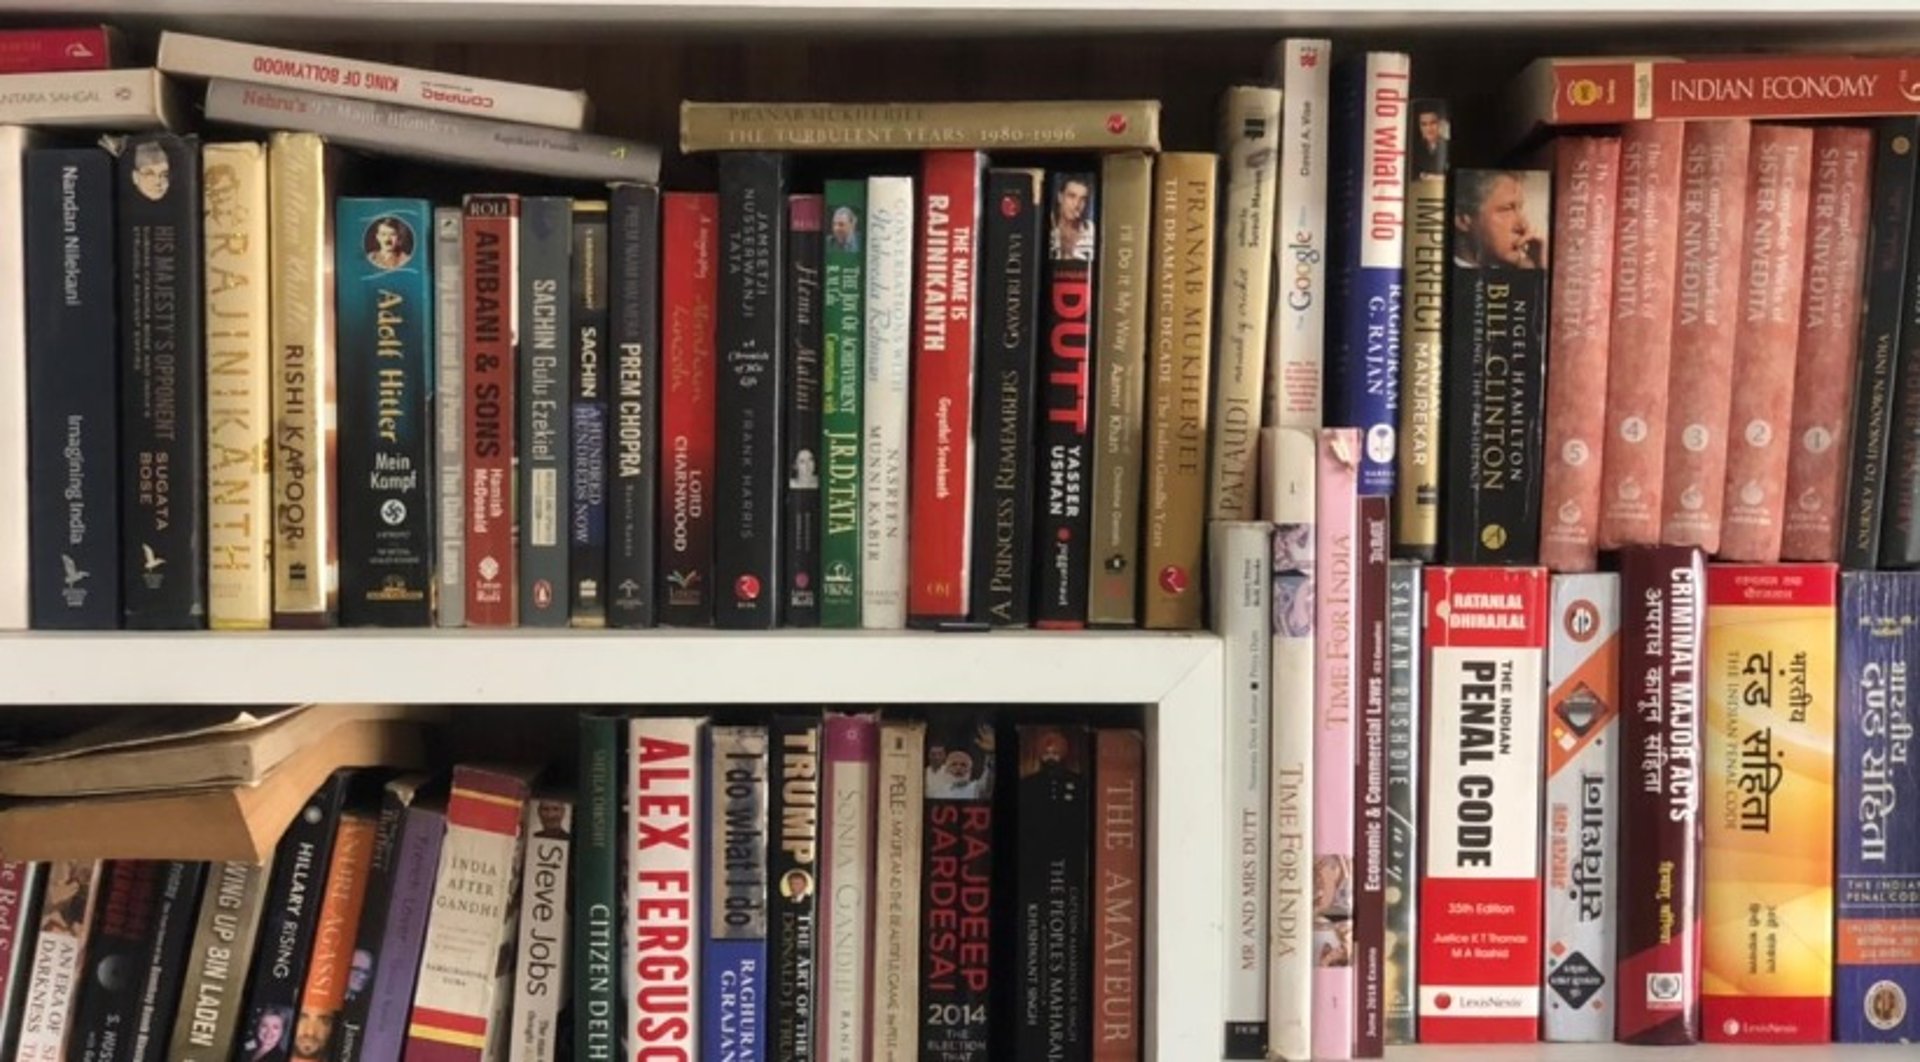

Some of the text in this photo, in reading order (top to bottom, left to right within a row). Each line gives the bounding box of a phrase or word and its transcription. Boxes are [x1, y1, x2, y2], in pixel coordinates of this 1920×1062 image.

[252, 56, 399, 93] KING OF BOLLYWOOD
[1299, 100, 1313, 126] Vise
[1670, 78, 1754, 101] INDIAN
[1761, 75, 1879, 100] ECONOMY
[729, 128, 1077, 143] THE TURBULENT YEARS 1980-1996
[1299, 142, 1312, 177] David
[1369, 71, 1408, 243] I do what I do
[62, 165, 82, 307] Nandan Nilekani
[730, 232, 742, 274] TATA
[743, 188, 756, 318] NUSSERWANJI
[756, 212, 769, 296] JAMSETJI
[924, 194, 950, 351] RAJINIKANTH
[950, 227, 971, 321] THE NAME IS
[1287, 229, 1321, 312] Google
[1411, 196, 1446, 334] IMPERFECT
[1617, 142, 1641, 319] SISTER NIVEDITA
[531, 279, 557, 350] SACHIN
[1157, 177, 1178, 383] THE DRAMATIC DECADE
[1178, 179, 1207, 475] PRANAB MUKHERJEE
[376, 288, 405, 443] Adolf Hitler
[474, 230, 501, 460] AMBANI & SONS
[531, 355, 557, 396] Gulu
[580, 326, 597, 399] SACHIN
[619, 343, 642, 397] PREM
[794, 264, 819, 411] Hema Malini
[1048, 281, 1090, 434] DUTT
[1366, 295, 1387, 396] G. RAJAN
[1385, 283, 1402, 410] RAGHURAM
[531, 399, 557, 462] Ezekiel
[989, 233, 1023, 621] A PRINCESS REMEMBERS GAYATRI DEVI
[1411, 342, 1430, 466] MANJREKAR
[1482, 281, 1510, 491] BILL CLINTON
[1509, 300, 1527, 482] NIGEL HAMILTON
[65, 414, 87, 545] Imagining India
[139, 452, 153, 505] BOSE
[284, 344, 305, 544] RISHI KAPOOR
[369, 469, 418, 493] Kampf
[375, 452, 411, 472] Mein
[618, 401, 642, 479] CHOPRA
[1049, 445, 1064, 515] USMAN
[1065, 446, 1082, 518] YASSER
[1218, 397, 1252, 513] PATAUDI
[155, 452, 169, 532] SUGATA
[473, 468, 488, 534] McDonald
[489, 468, 504, 518] Hamish
[673, 435, 688, 552] CHARNWOOD
[689, 469, 702, 519] LORD
[866, 425, 882, 562] MUNNI KABIR
[886, 449, 900, 540] NASREEN
[1055, 542, 1069, 606] juggernaut
[1450, 613, 1526, 630] DHIRAJLAL
[1452, 593, 1524, 610] RATANLAL
[1325, 533, 1352, 731] TIME FOR INDIA
[1391, 580, 1411, 670] SALMAN
[1498, 659, 1514, 755] THE INDIAN
[1637, 587, 1671, 795] अपराध कानून संहिता
[1669, 567, 1697, 823] CRIMINAL MAJOR ACTS
[1788, 650, 1814, 724] भारतीय
[1859, 661, 1888, 738] दण्ड
[1889, 659, 1914, 764] भारतीय
[723, 768, 764, 800] do
[725, 752, 762, 760] I
[1389, 687, 1410, 786] RUSHDIE
[1456, 660, 1497, 868] PENAL CODE
[1736, 649, 1786, 834] दंड संहिता
[638, 736, 690, 851] ALEX
[781, 727, 817, 866] TRUMP
[1364, 677, 1383, 893] Economic & Commercial Laws
[1859, 745, 1897, 862] संहिता
[448, 878, 495, 898] AFTER
[450, 857, 498, 877] INDIA
[723, 807, 763, 873] what
[1278, 762, 1304, 958] TIME FOR INDIA
[1568, 773, 1605, 923] संविधान
[272, 841, 315, 980] HILLARY RISING
[435, 896, 501, 919] GANDHI
[526, 844, 564, 997] Steve Jobs
[723, 896, 762, 927] do
[835, 788, 862, 995] SONIA GANDHI
[928, 804, 960, 992] SARDESAI
[959, 804, 991, 993] RAJDEEP
[1102, 778, 1136, 1042] THE AMATEUR
[1241, 807, 1258, 971] MR AND MRS DUTT
[26, 939, 57, 1034] DARKNESS
[49, 941, 75, 1036] AN ERA OF
[189, 914, 239, 1047] UP BIN LADEN
[311, 914, 346, 997] AGASSI
[589, 903, 611, 993] CITIZEN
[794, 913, 813, 1056] THE ART OF THE
[927, 1003, 987, 1027] 2014
[1366, 984, 1376, 1010] 2018
[1366, 1011, 1377, 1038] June
